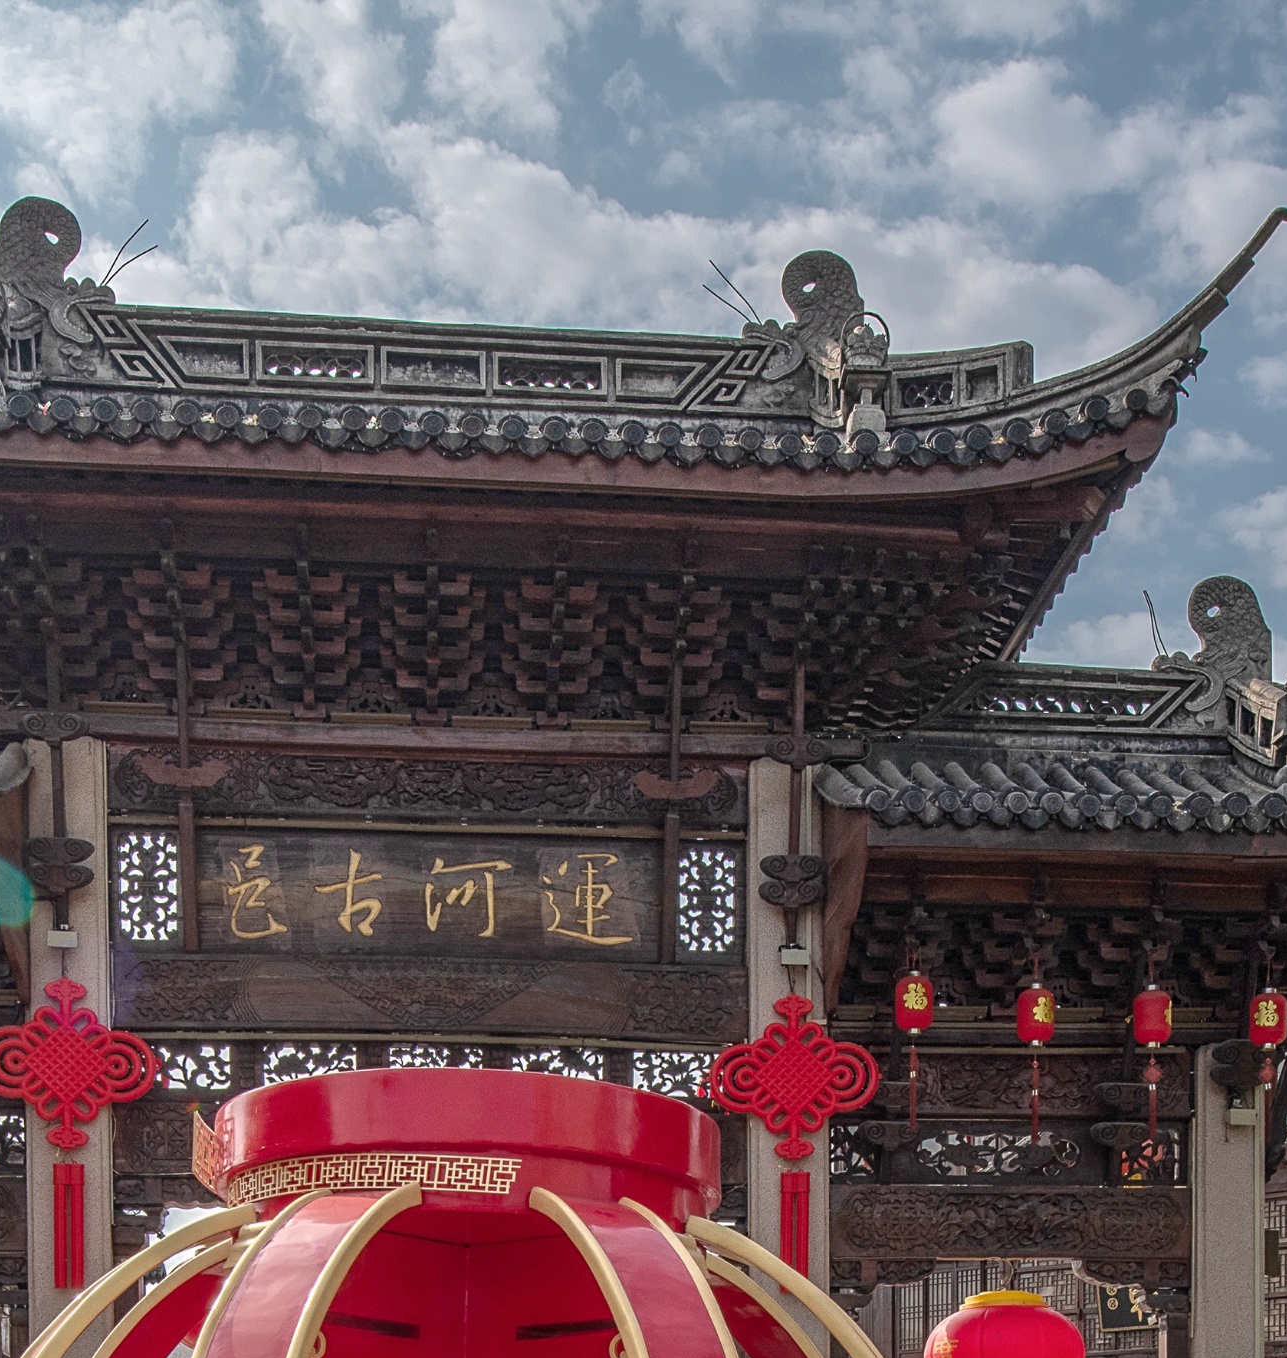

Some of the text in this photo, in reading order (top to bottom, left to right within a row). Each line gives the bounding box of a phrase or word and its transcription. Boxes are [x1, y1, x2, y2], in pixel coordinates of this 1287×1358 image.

[902, 982, 928, 1010] 福
[1032, 996, 1054, 1024] 福
[1254, 999, 1280, 1027] 福
